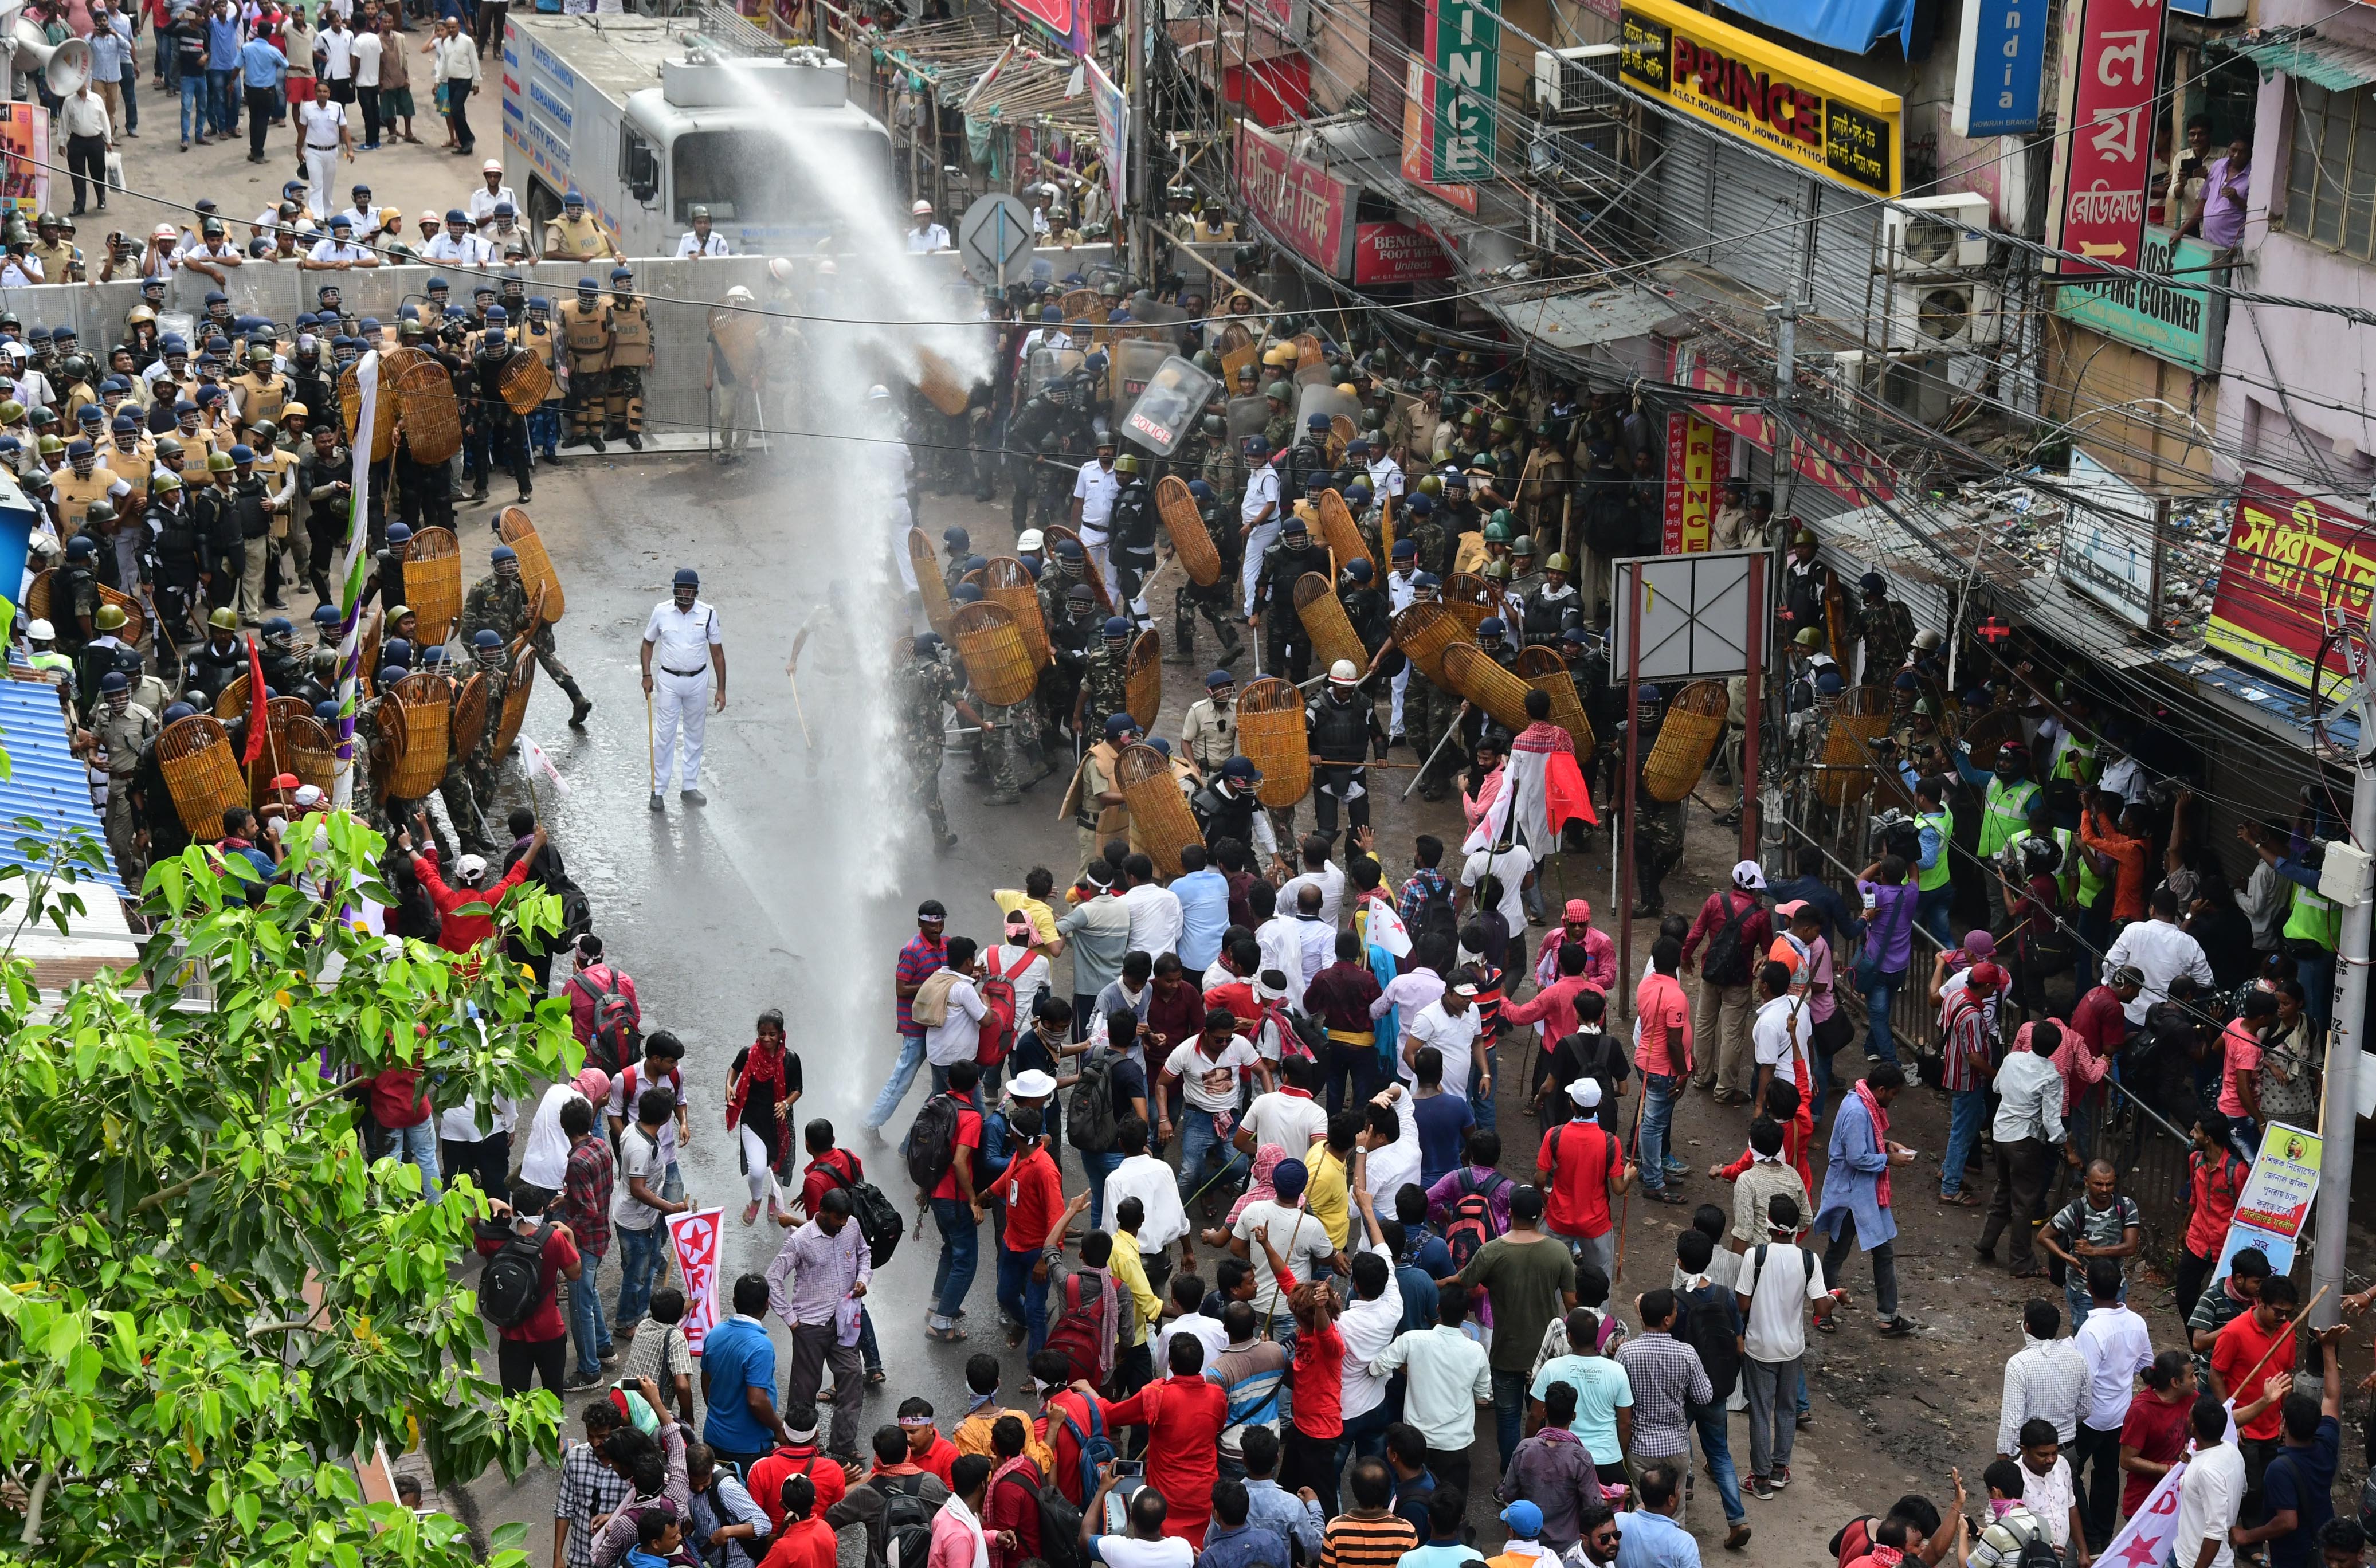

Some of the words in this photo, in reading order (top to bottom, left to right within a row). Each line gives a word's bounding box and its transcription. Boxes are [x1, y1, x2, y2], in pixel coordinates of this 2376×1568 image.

[1998, 0, 2020, 108] ndia
[551, 61, 573, 90] CANNON
[1445, 0, 1481, 171] INCE
[1674, 35, 1822, 146] PRINCE
[530, 83, 572, 129] BIDHANNAGAR
[1973, 120, 2003, 128] HOWRAH
[529, 120, 544, 143] CITY
[546, 133, 571, 167] POLICE
[2068, 178, 2142, 226] রেডিমেড
[1379, 249, 1412, 261] FOOT
[2143, 241, 2176, 276] OSE
[2138, 280, 2201, 334] CORNER
[1132, 414, 1171, 444] POLICE
[185, 460, 205, 470] OLICE
[2335, 683, 2353, 696] Mark
[2336, 959, 2349, 969] ESC
[1676, 1012, 1683, 1022] 3
[2265, 1154, 2285, 1167] শিক্ষক
[2286, 1160, 2316, 1177] নিয়োগের
[2264, 1171, 2287, 1185] জোনাল
[2289, 1178, 2308, 1191] অফিস
[2256, 1199, 2275, 1211] করতে
[2263, 1186, 2284, 1199] পুনরায়
[2285, 1192, 2299, 1205] চালু
[2242, 1209, 2272, 1225] সারাভারত
[2273, 1218, 2295, 1232] যুবলীগ
[1569, 1364, 1603, 1374] Freedom
